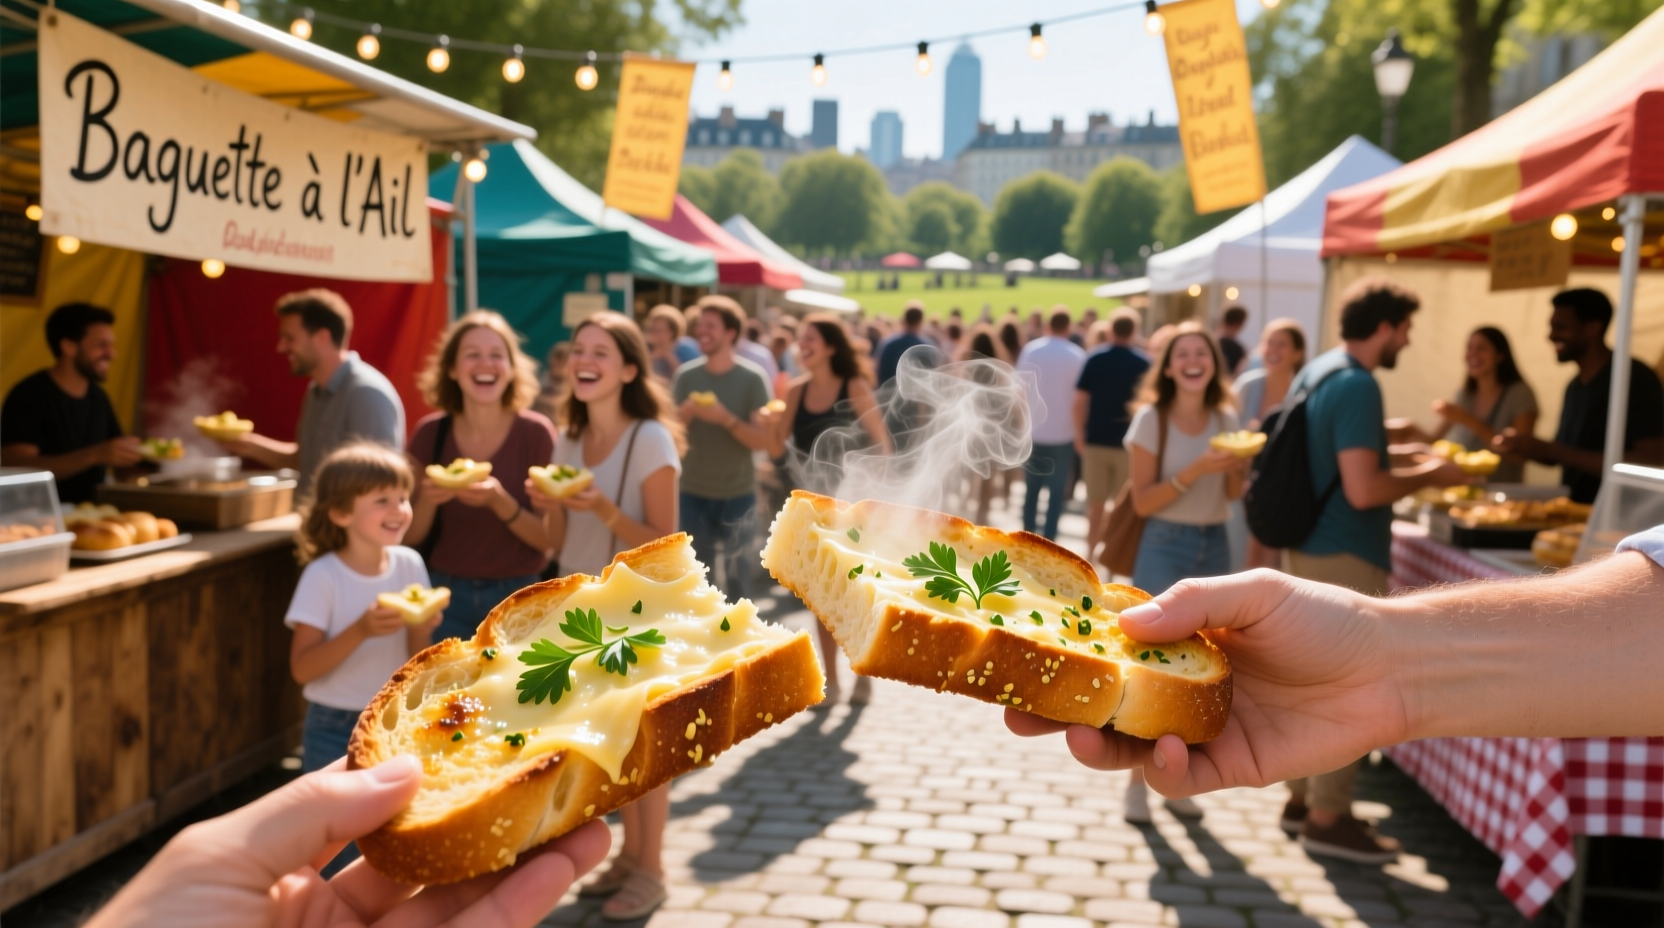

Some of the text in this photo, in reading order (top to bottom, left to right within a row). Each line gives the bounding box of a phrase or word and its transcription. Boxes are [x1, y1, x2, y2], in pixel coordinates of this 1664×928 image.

[63, 57, 415, 239] Baguette à l'Ail
